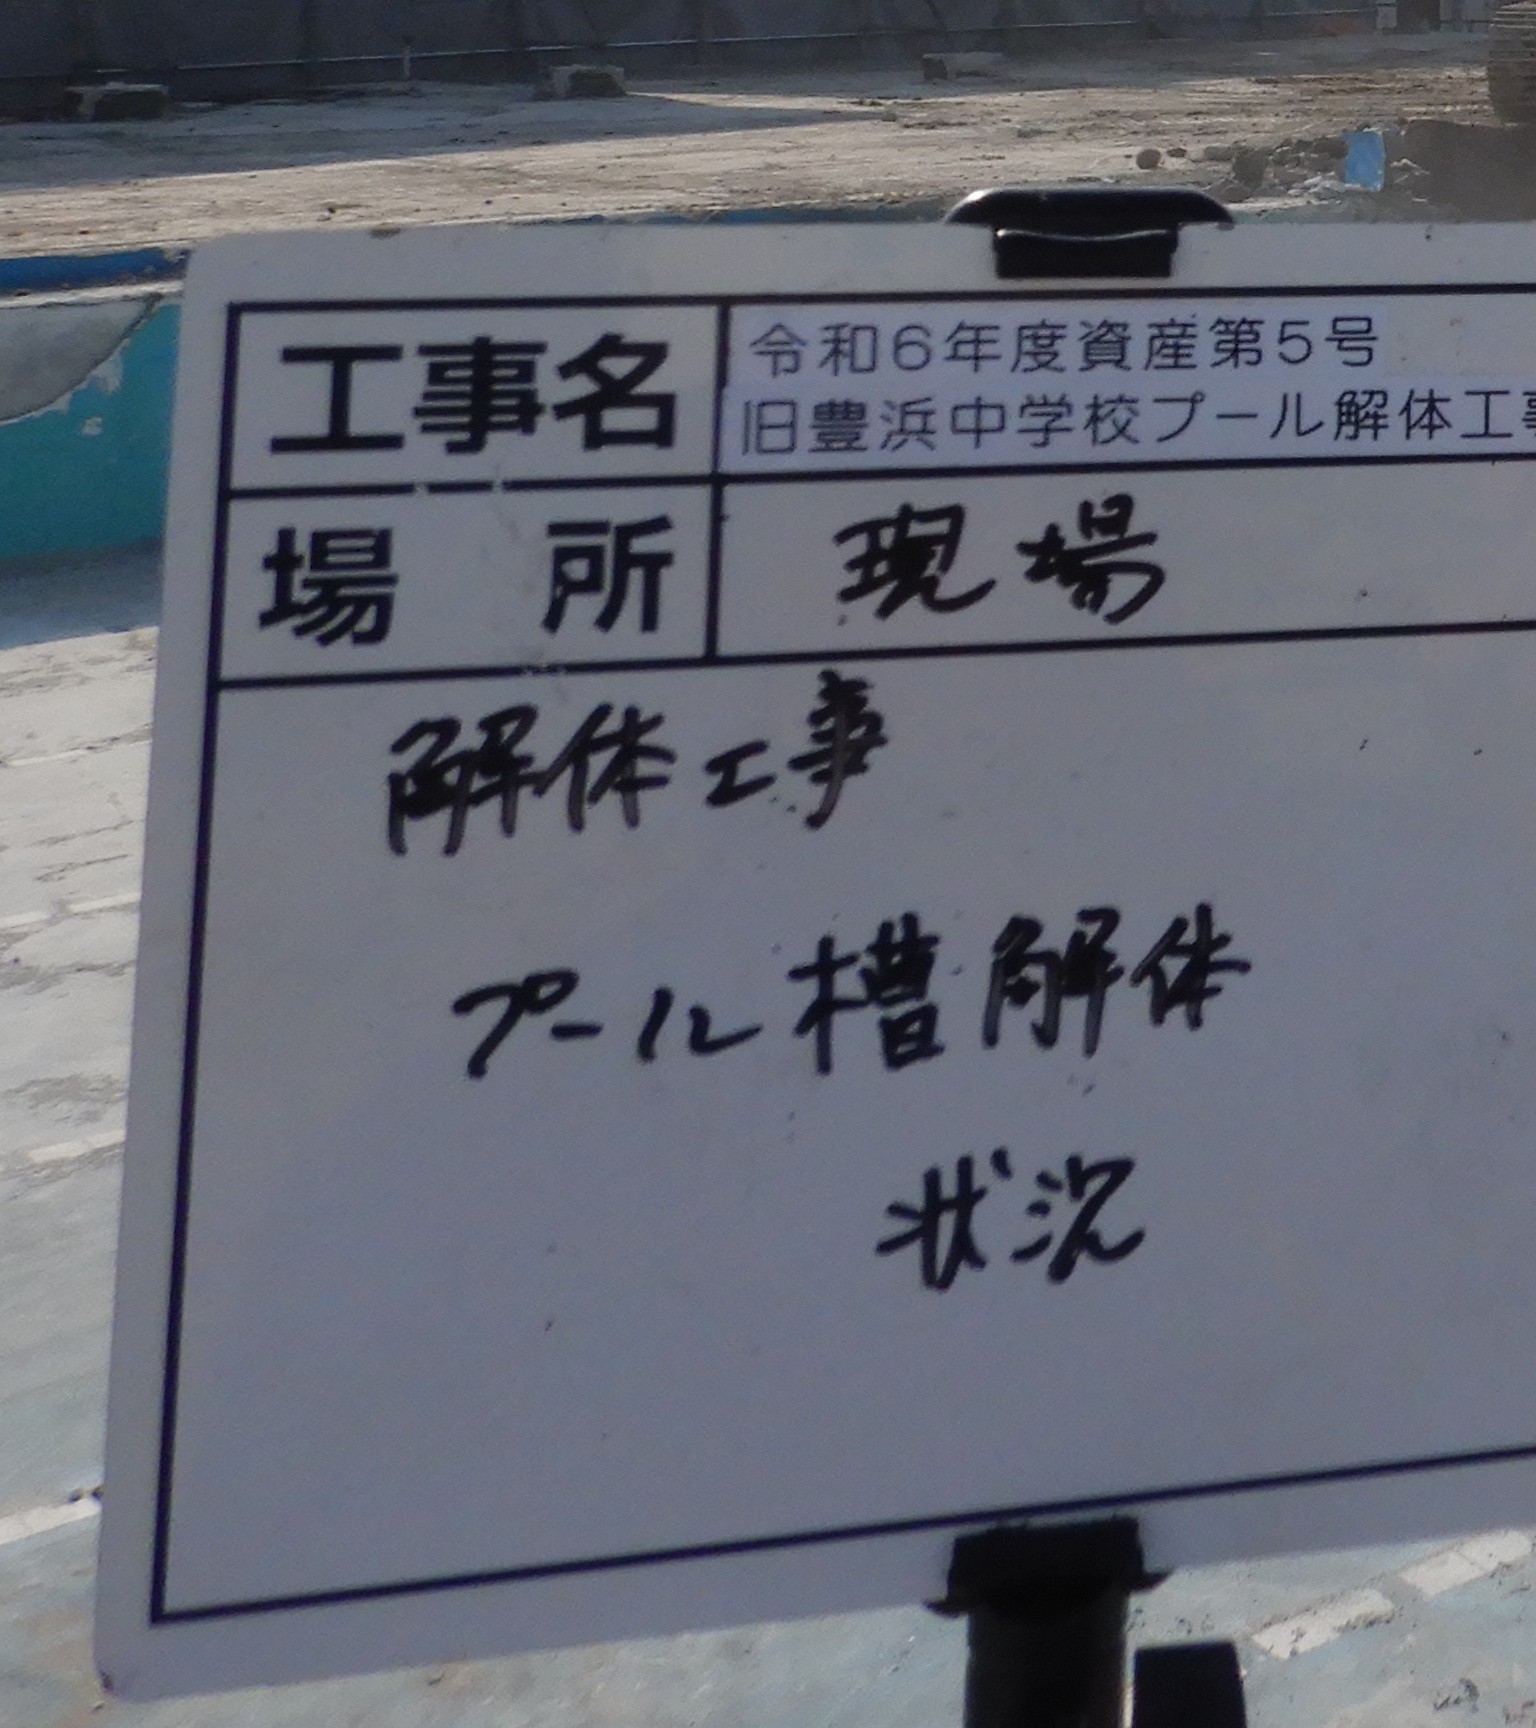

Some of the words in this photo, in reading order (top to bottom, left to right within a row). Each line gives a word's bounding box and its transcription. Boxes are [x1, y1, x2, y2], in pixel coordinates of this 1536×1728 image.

[269, 332, 678, 456] 工事名
[749, 315, 1379, 378] 令和6年度資産第5号
[832, 492, 1168, 626] 現場
[384, 667, 889, 858] 解体工事
[450, 901, 1253, 1081] プール槽解体
[875, 1146, 1147, 1293] 状況
